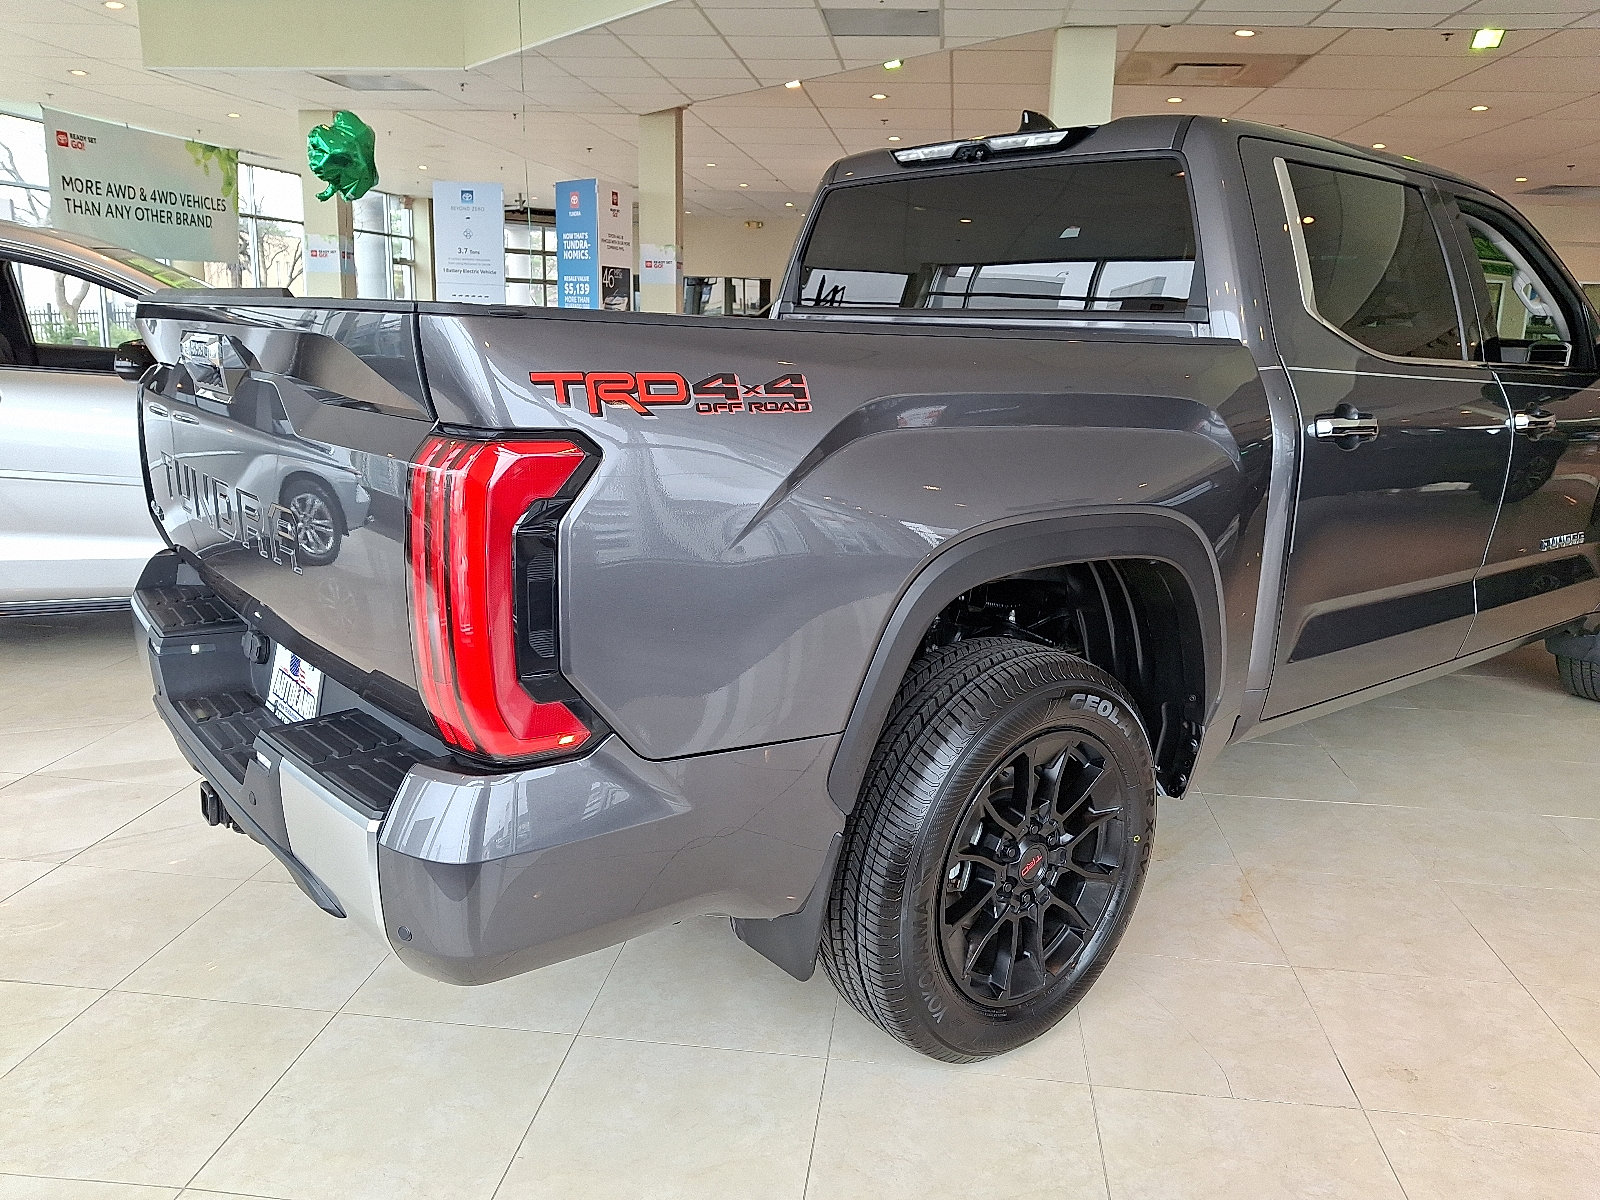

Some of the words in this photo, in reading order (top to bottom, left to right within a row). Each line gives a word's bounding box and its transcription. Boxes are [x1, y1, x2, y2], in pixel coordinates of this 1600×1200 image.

[71, 140, 86, 151] GO!
[61, 175, 102, 197] MORE
[106, 182, 136, 201] AWD
[139, 187, 147, 201] &
[150, 189, 178, 206] 4WD
[180, 193, 227, 212] VEHICLES
[64, 197, 101, 217] THAN
[105, 203, 132, 221] ANY
[134, 207, 173, 225] OTHER
[563, 240, 591, 250] TUNDRA-
[563, 250, 591, 260] NOMICS.
[602, 268, 615, 288] 46
[564, 282, 590, 296] $5,139
[529, 371, 693, 418] TRD
[695, 402, 743, 415] OFF
[747, 401, 812, 414] ROAD
